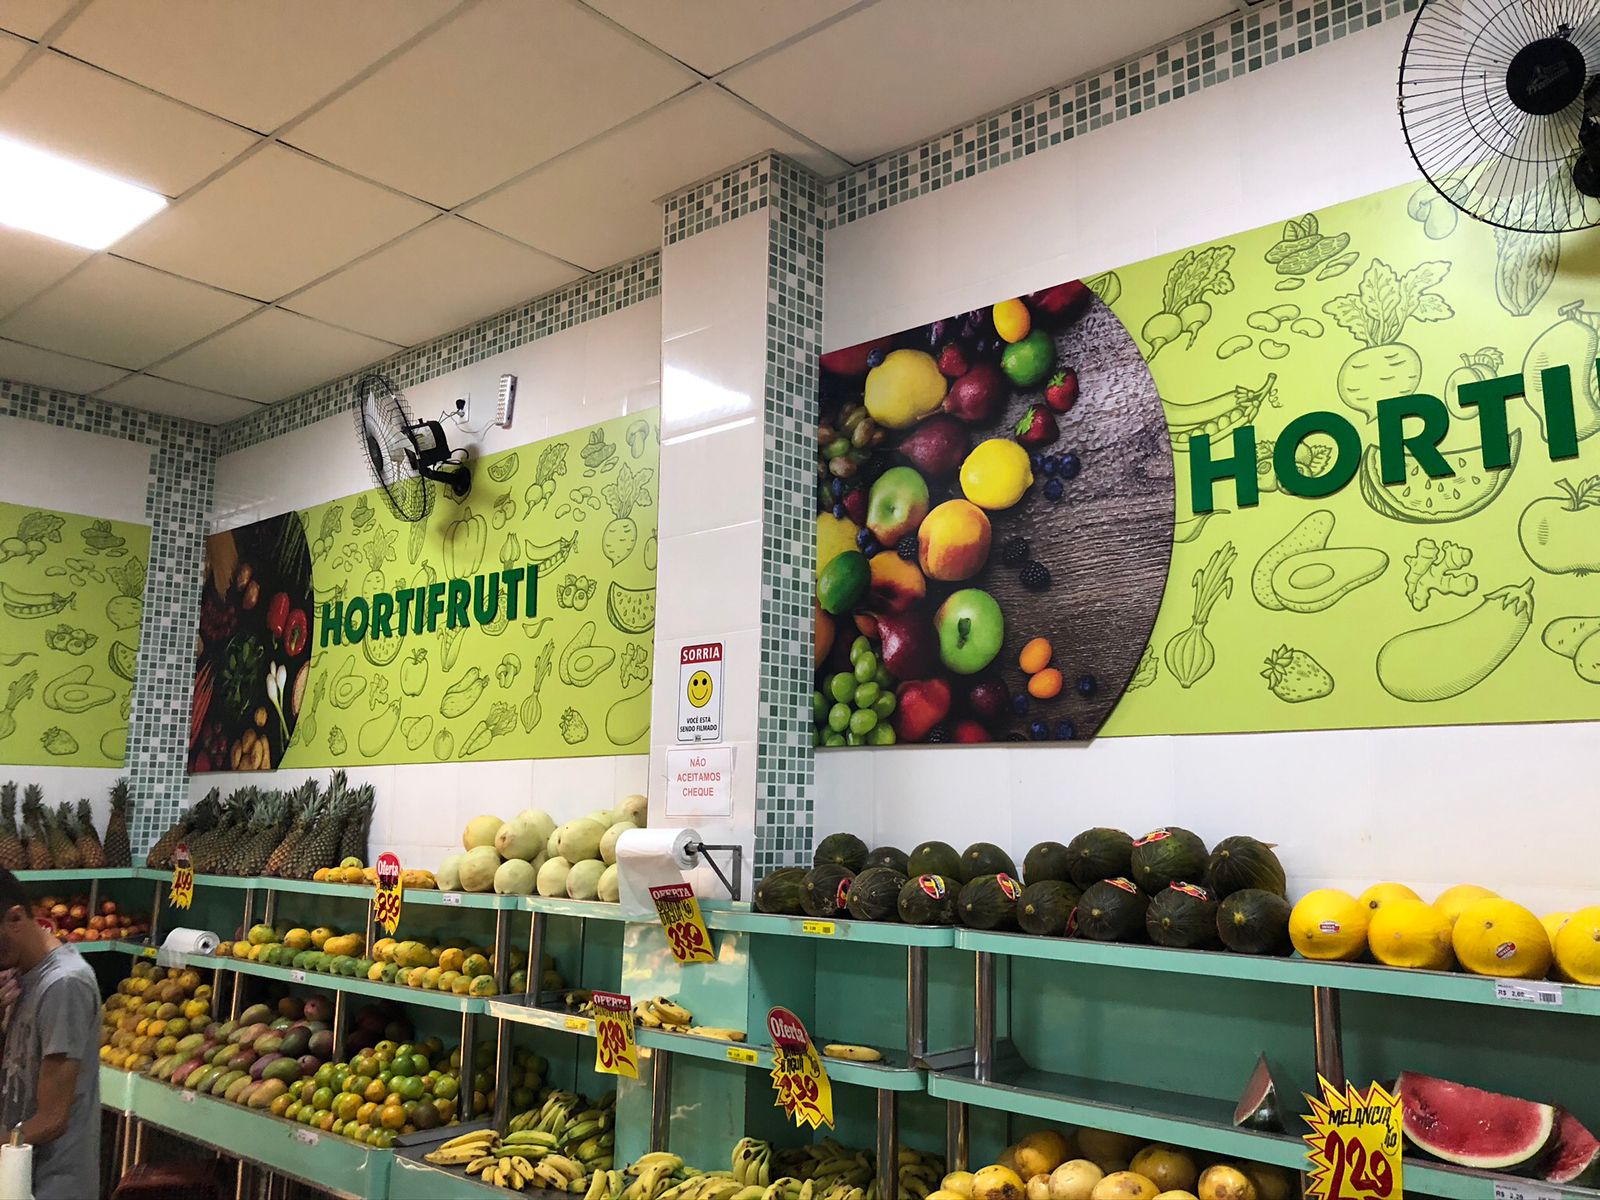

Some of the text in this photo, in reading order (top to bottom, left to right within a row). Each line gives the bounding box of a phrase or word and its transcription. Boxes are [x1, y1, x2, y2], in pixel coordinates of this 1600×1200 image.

[1188, 358, 1600, 516] HORTI
[320, 563, 539, 648] HORTIFRUTI
[682, 646, 720, 662] SORRIA
[680, 725, 695, 733] SENDO
[690, 756, 707, 767] NÃO
[677, 772, 721, 782] ACEITAMOS
[682, 787, 714, 797] CHEQUE
[652, 887, 692, 900] OFERTA
[770, 1017, 806, 1043] Oferta
[1328, 1105, 1392, 1131] MELANCIA
